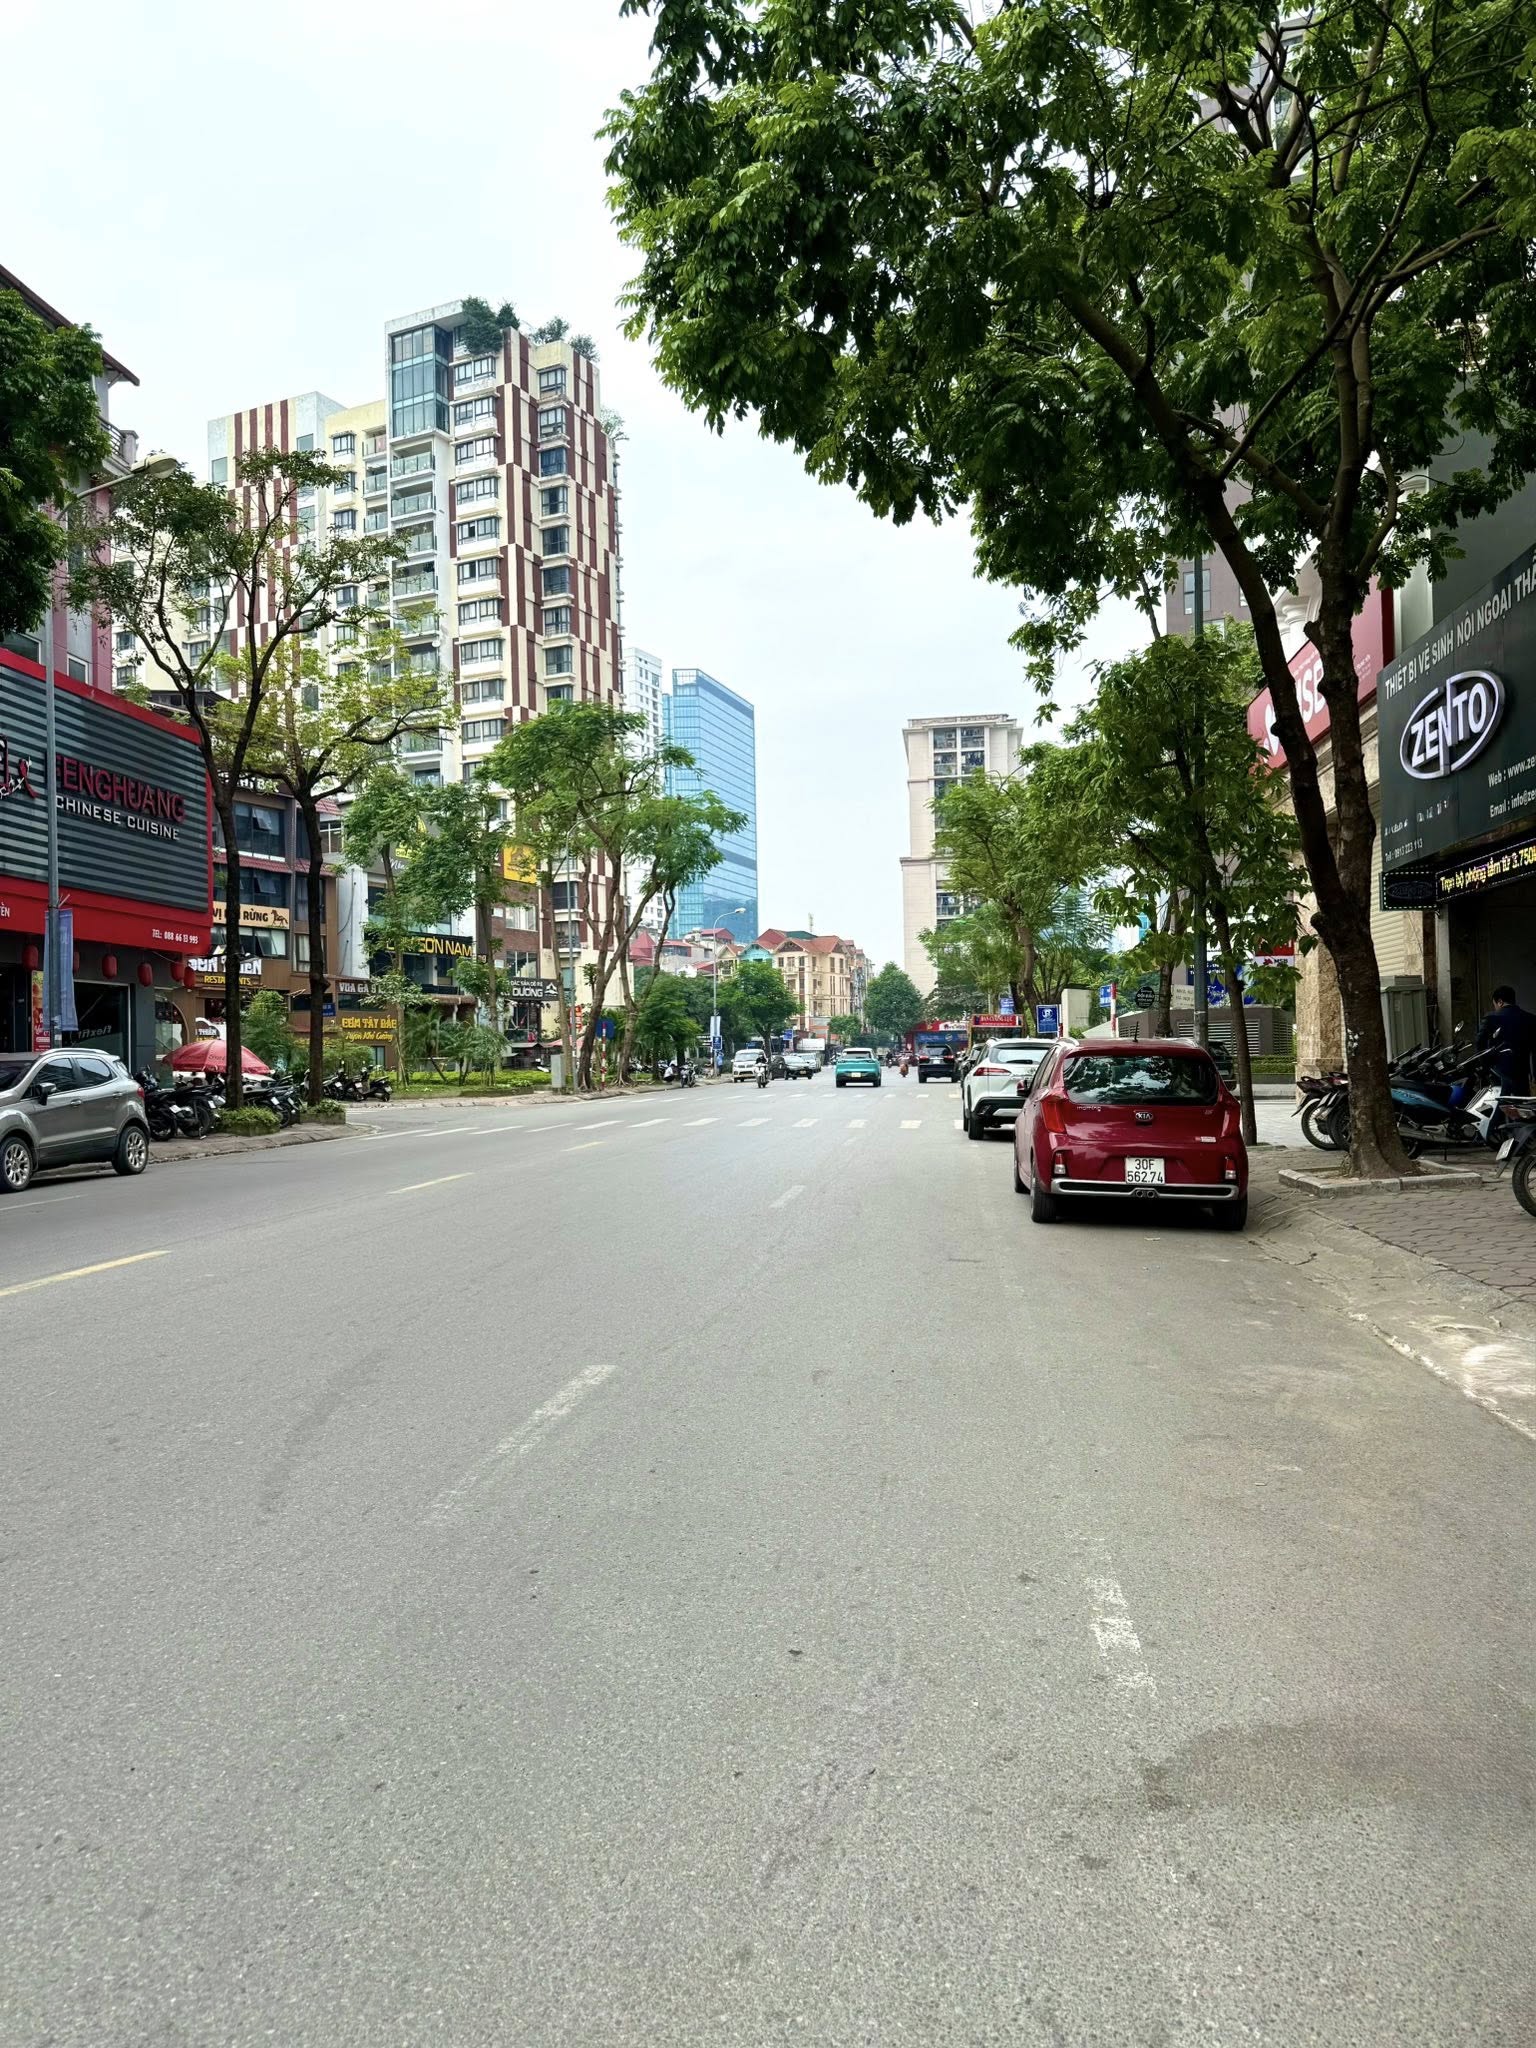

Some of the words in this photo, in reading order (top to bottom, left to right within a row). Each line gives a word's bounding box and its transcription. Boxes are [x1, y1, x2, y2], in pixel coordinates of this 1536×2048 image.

[1385, 664, 1408, 700] THIẾT
[1408, 661, 1417, 684] BỊ
[1418, 643, 1431, 675] VỆ
[1432, 630, 1454, 665] SINH
[1456, 611, 1475, 647] NỘI
[1477, 584, 1512, 632] NGOẠI
[1411, 682, 1487, 769] ZENTO
[1488, 770, 1502, 787] Web
[1508, 755, 1536, 778] www.ze
[1490, 799, 1507, 818] Email
[1511, 790, 1536, 809] info@ze
[56, 795, 122, 825] CHINESE
[127, 815, 181, 840] CUISINE
[243, 908, 269, 922] RỪNG
[164, 931, 174, 940] 088
[175, 933, 182, 942] 66
[445, 940, 473, 957] NAM
[205, 976, 251, 986] RESTANTS
[339, 982, 356, 993] VUA
[357, 981, 369, 993] GÀ
[362, 1016, 379, 1029] TÂY
[1135, 1158, 1155, 1170] 30F
[1127, 1171, 1164, 1183] 562.74
